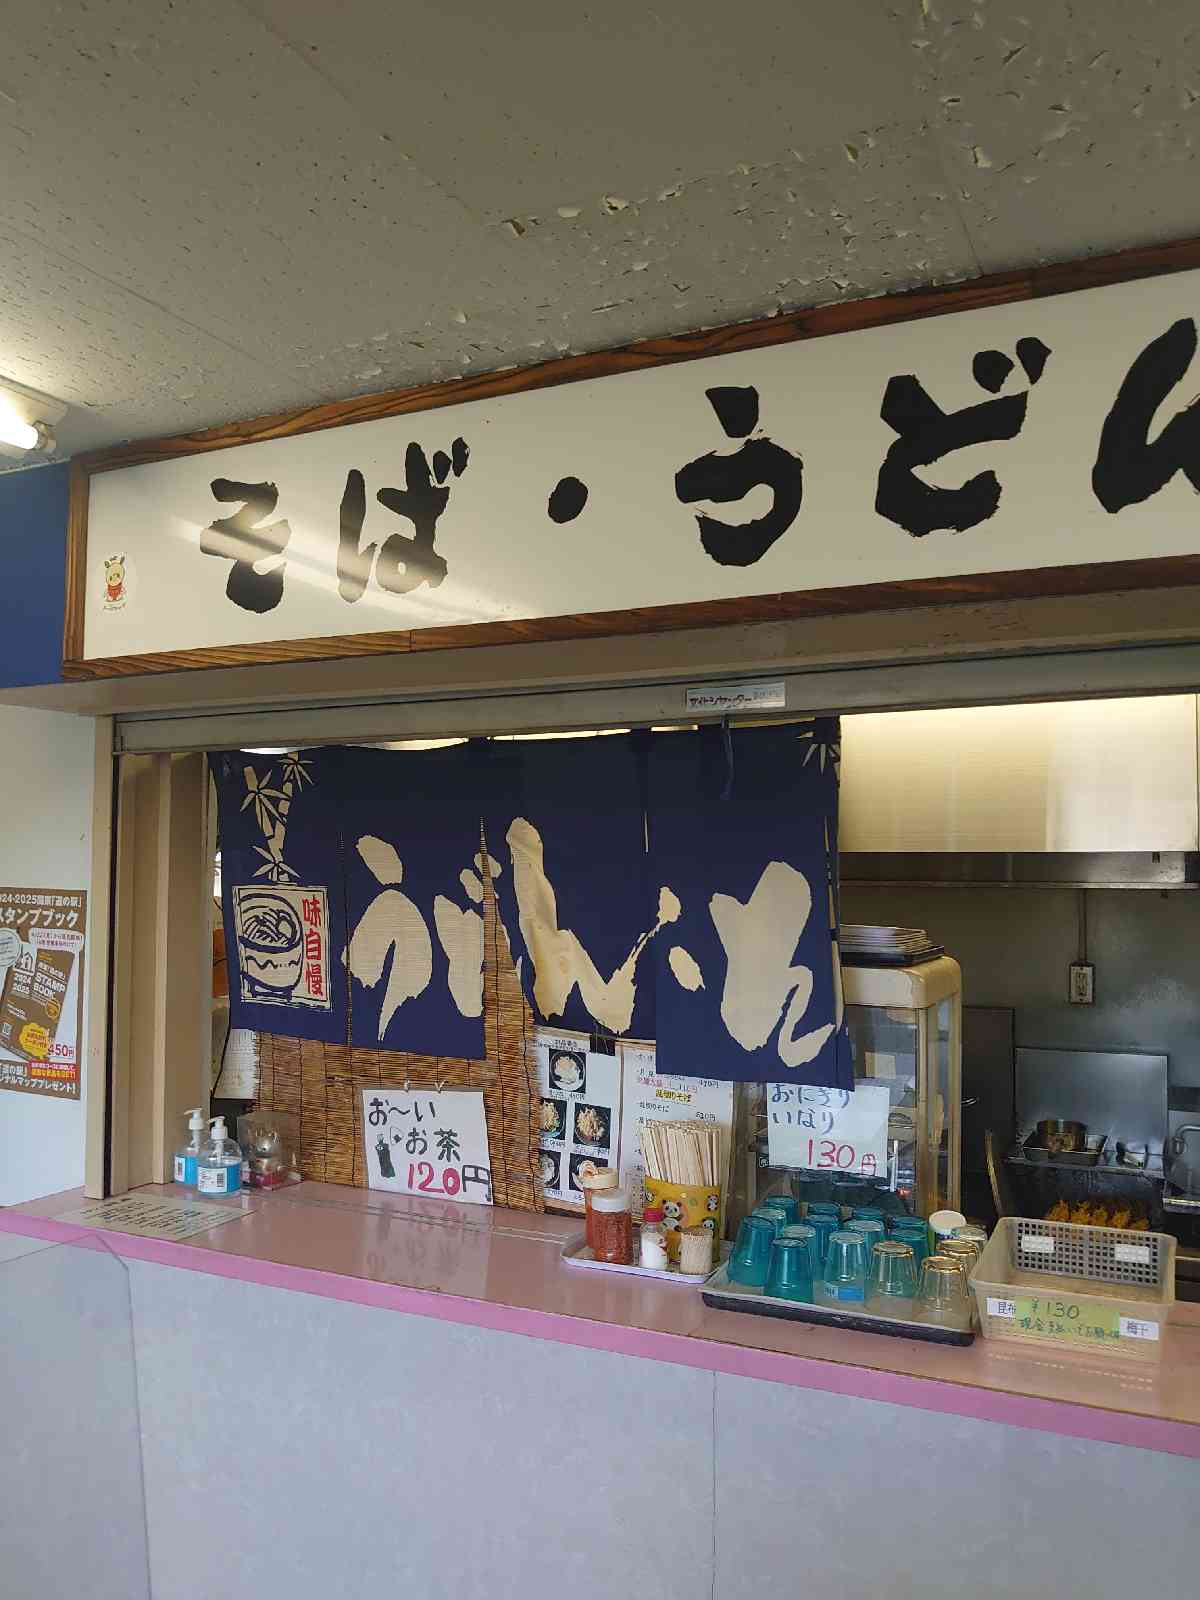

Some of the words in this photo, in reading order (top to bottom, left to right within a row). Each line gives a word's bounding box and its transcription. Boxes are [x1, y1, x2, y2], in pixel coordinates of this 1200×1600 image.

[302, 894, 323, 997] 味自慢
[772, 1107, 834, 1136] いなり
[405, 1127, 461, 1162] お茶
[408, 1162, 492, 1202] 120円
